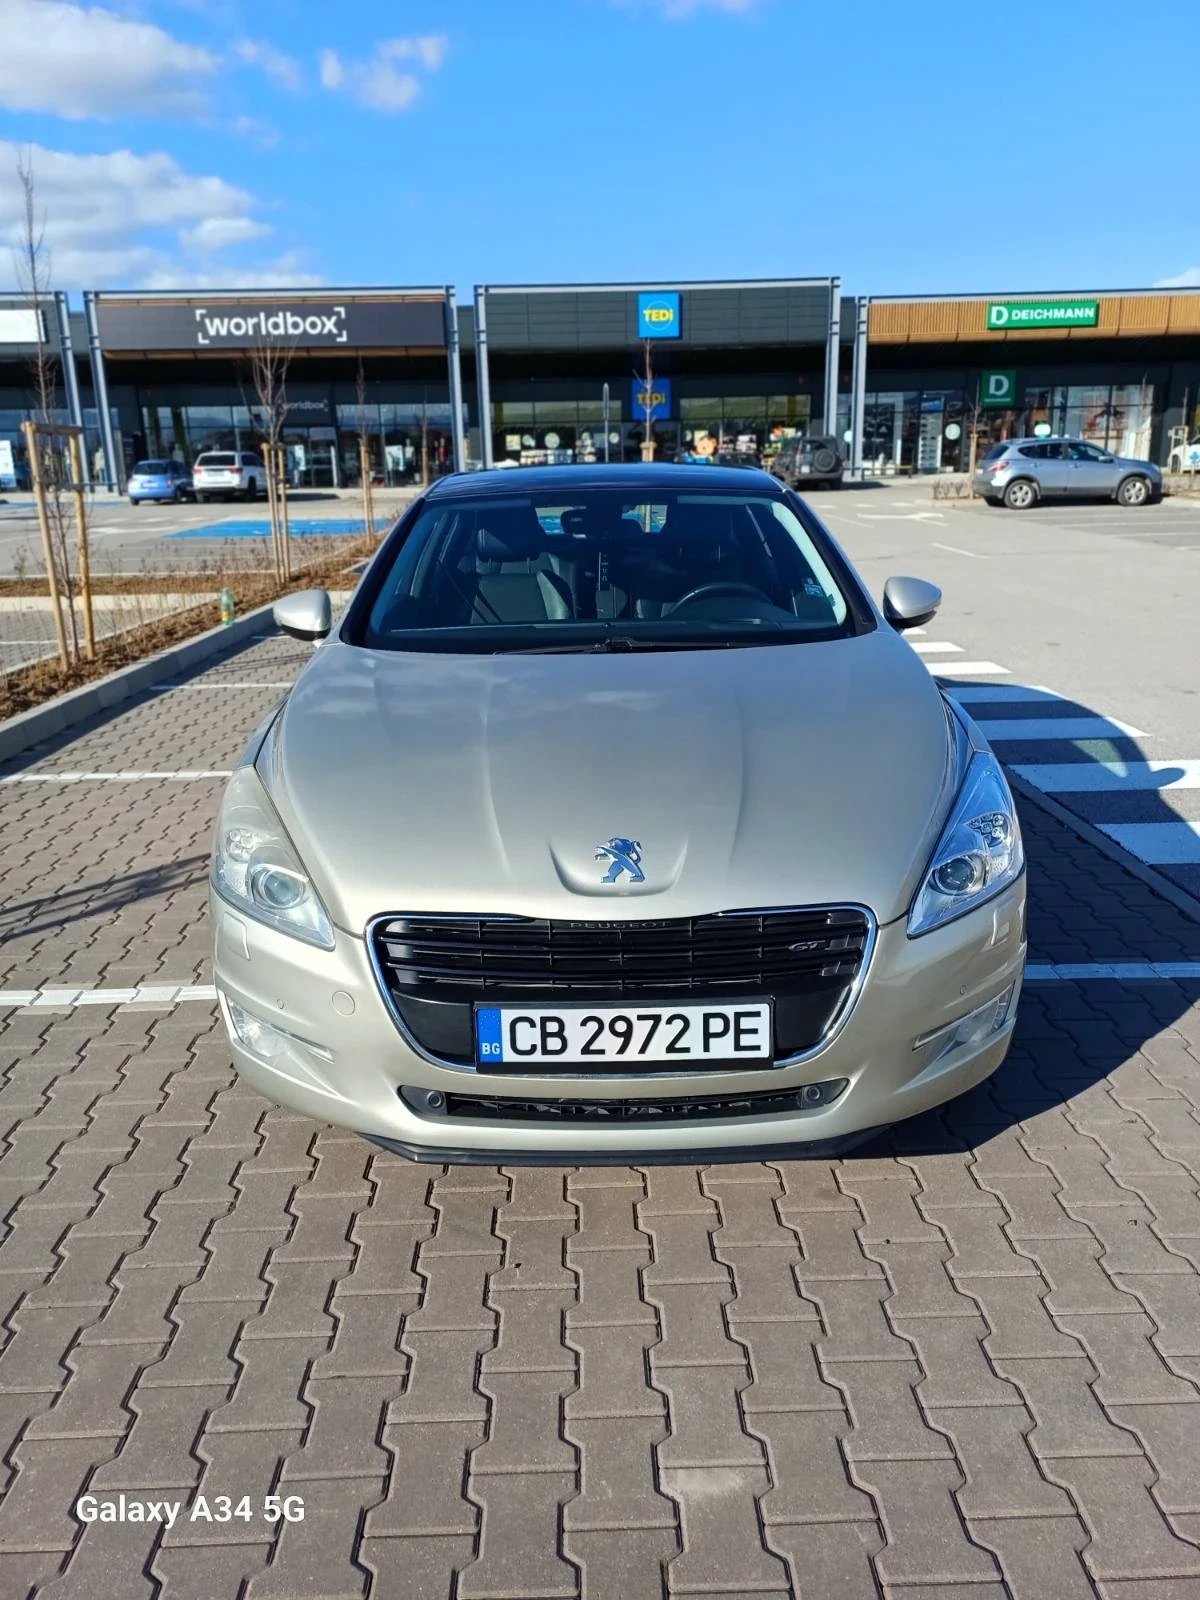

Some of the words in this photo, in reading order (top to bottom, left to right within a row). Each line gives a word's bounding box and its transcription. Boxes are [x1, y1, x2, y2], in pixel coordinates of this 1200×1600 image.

[1012, 308, 1095, 320] DEICHMANN
[204, 312, 338, 336] worldbox
[570, 921, 672, 929] PEUGEOT
[509, 1016, 568, 1056] CB
[580, 1013, 691, 1055] 2972
[702, 1011, 762, 1053] PE
[482, 1043, 500, 1054] BG
